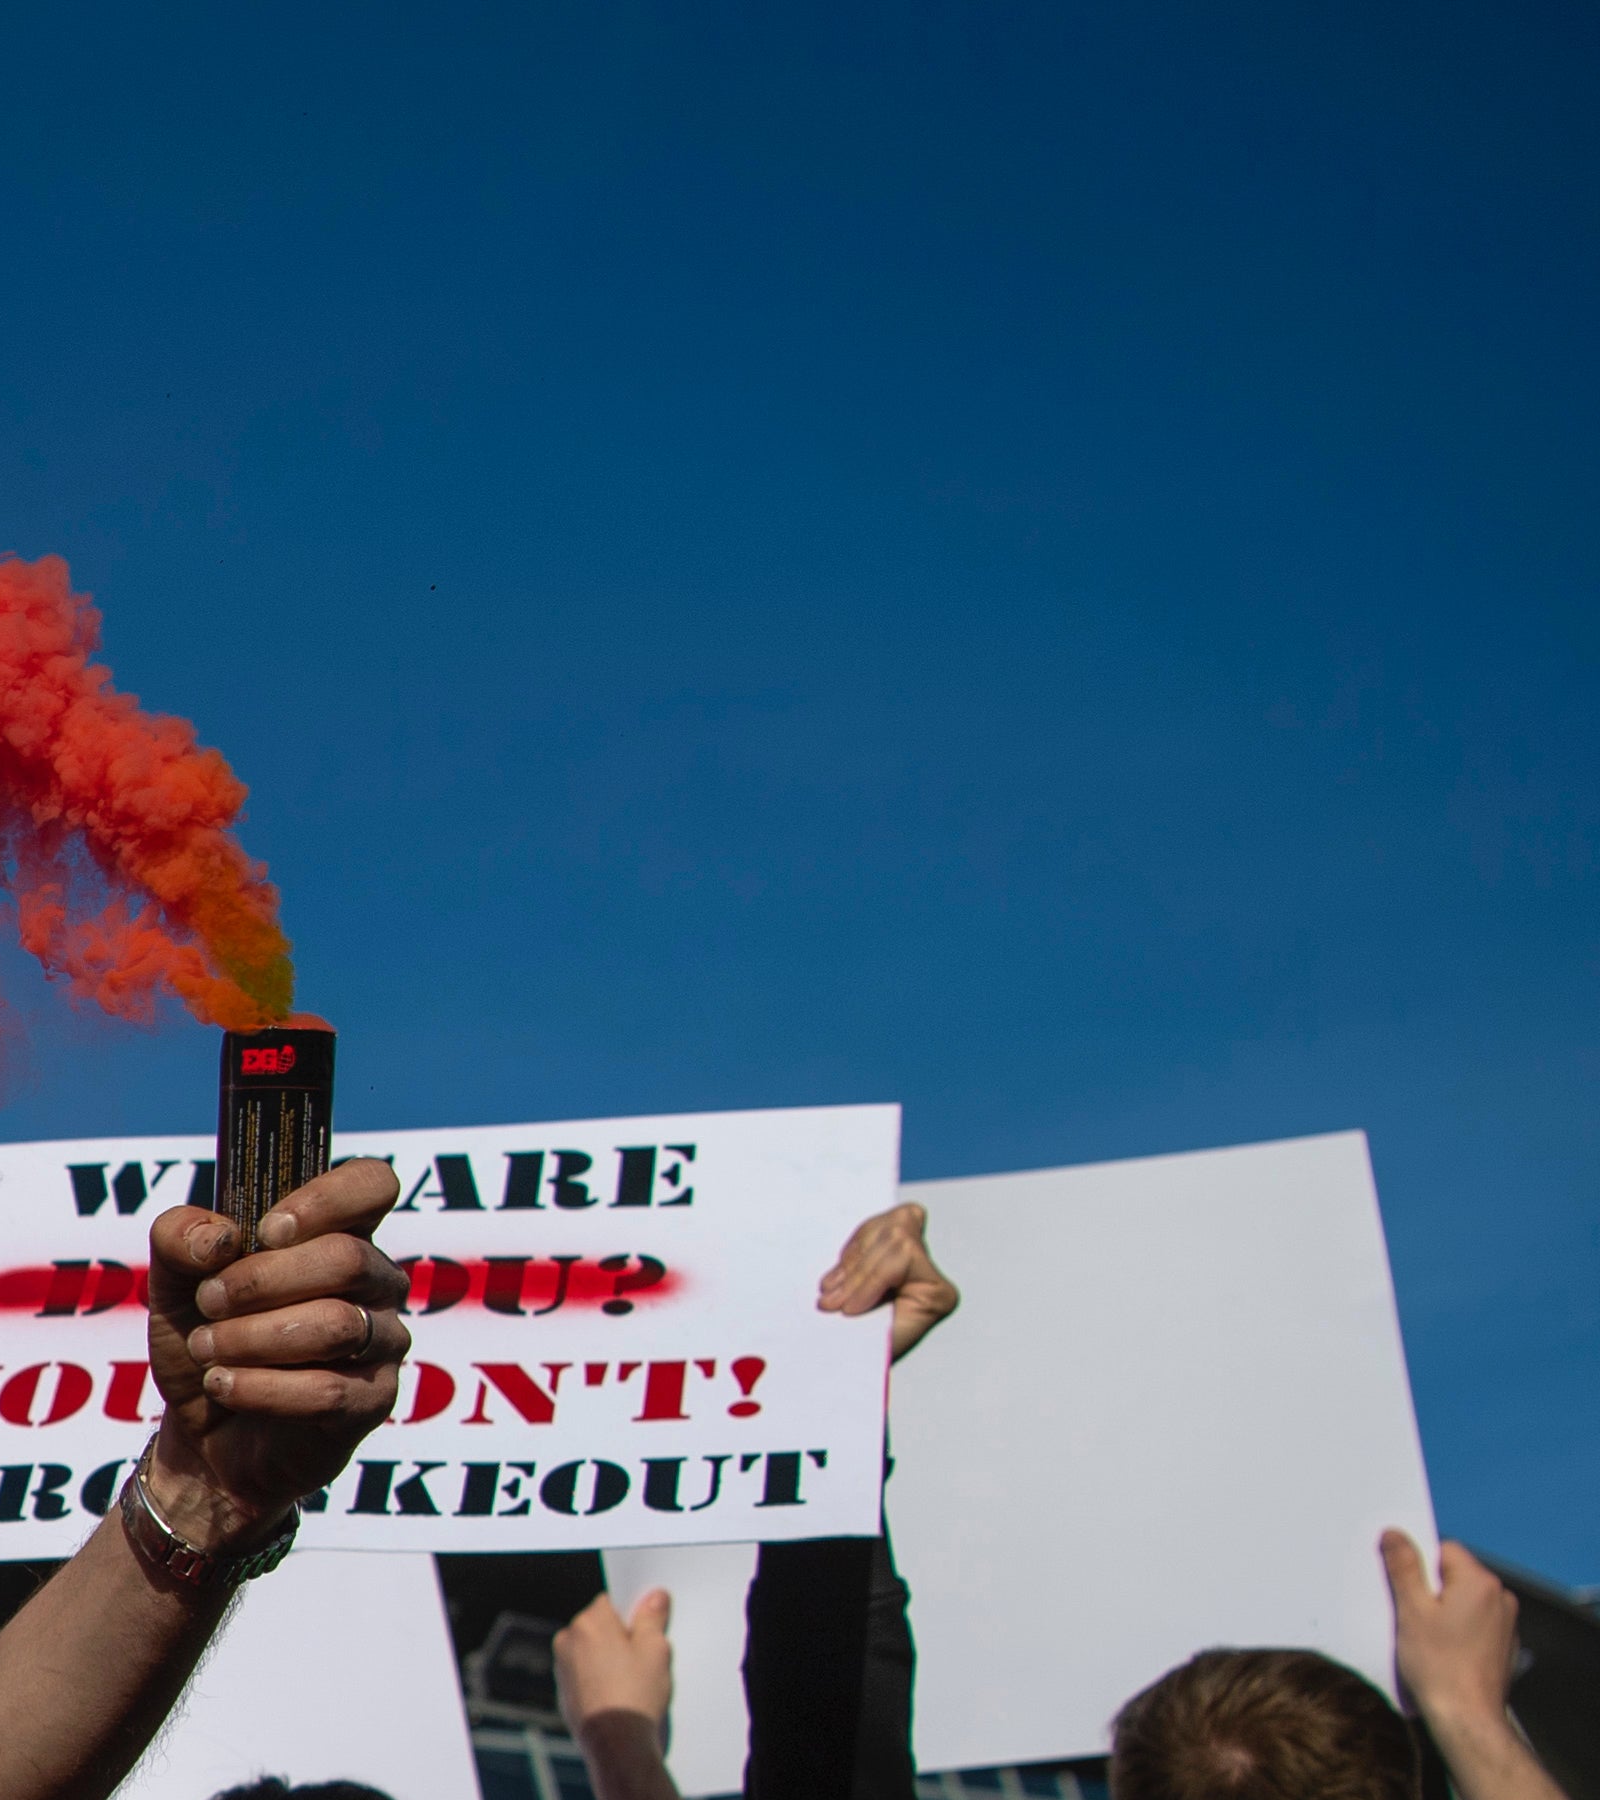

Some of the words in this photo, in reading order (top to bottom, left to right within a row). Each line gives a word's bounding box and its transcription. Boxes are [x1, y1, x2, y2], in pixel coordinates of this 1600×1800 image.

[67, 1160, 216, 1217] W
[392, 1142, 698, 1213] ARE
[38, 1258, 150, 1318] D
[396, 1253, 668, 1319] OU?
